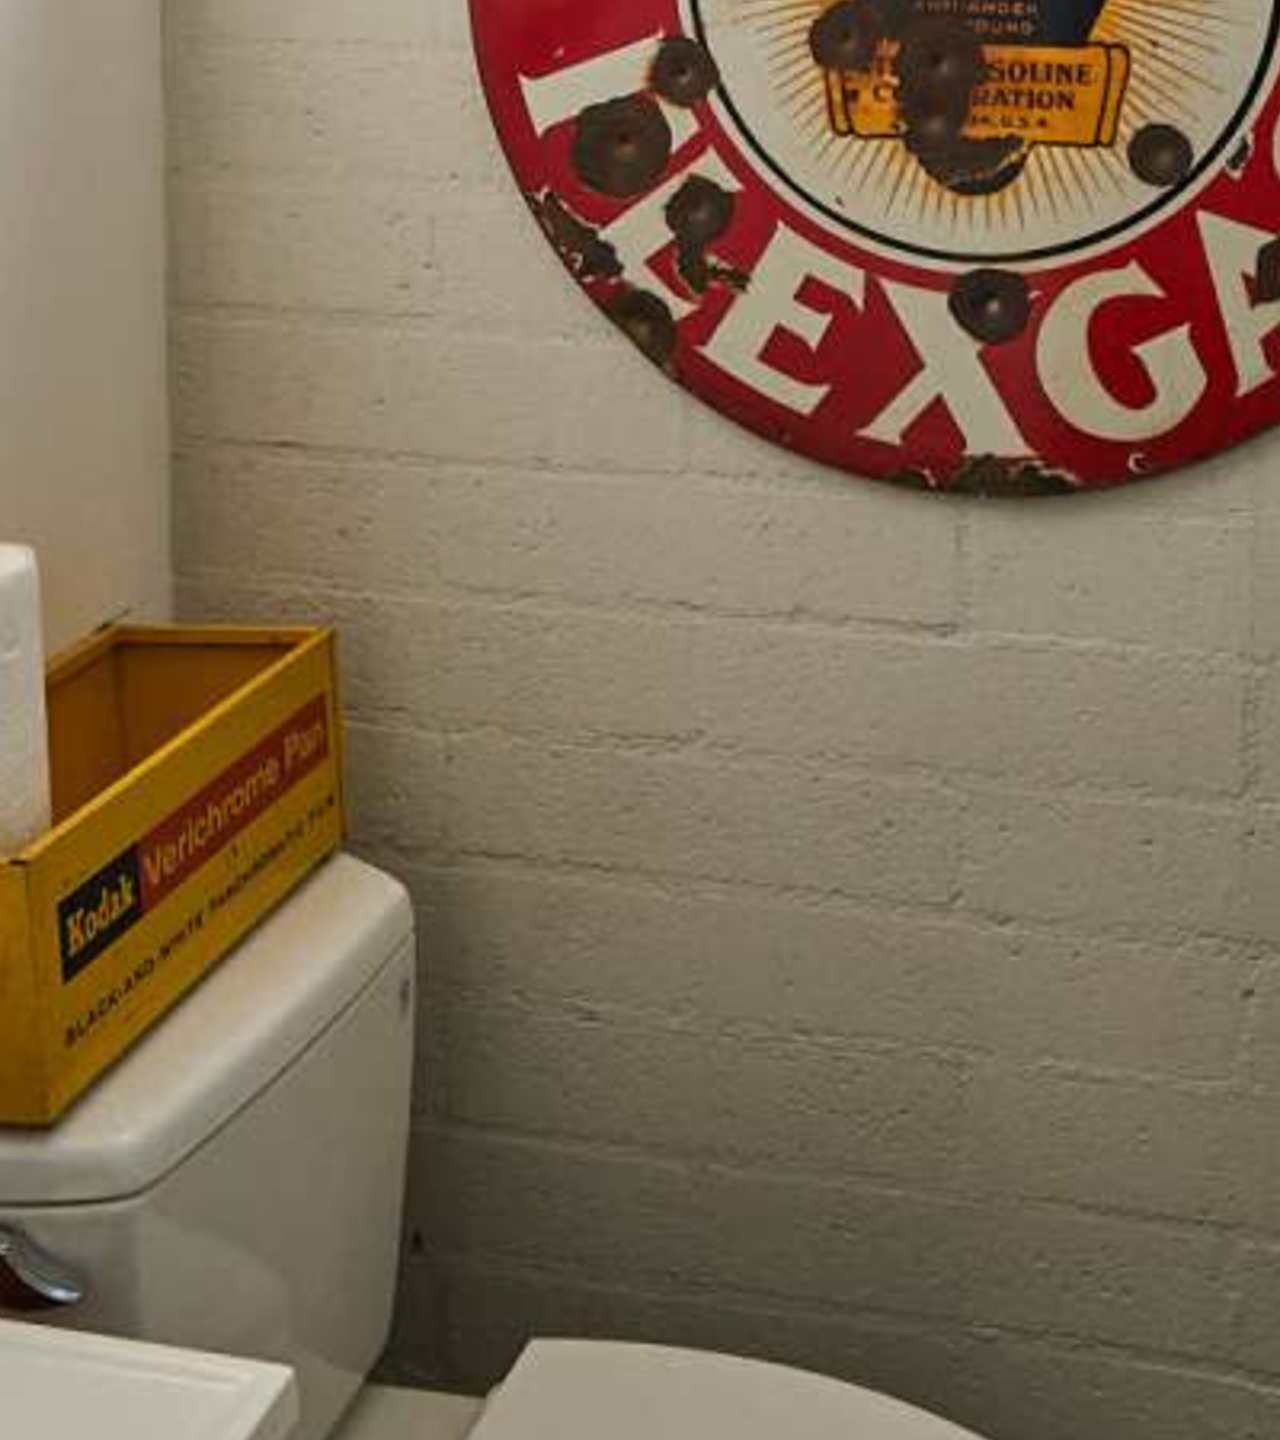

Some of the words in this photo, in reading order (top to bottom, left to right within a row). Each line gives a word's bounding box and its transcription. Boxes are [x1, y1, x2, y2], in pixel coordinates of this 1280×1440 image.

[984, 60, 1094, 88] SOLINE
[67, 873, 135, 958] Kodak
[142, 757, 280, 885] Verichrome
